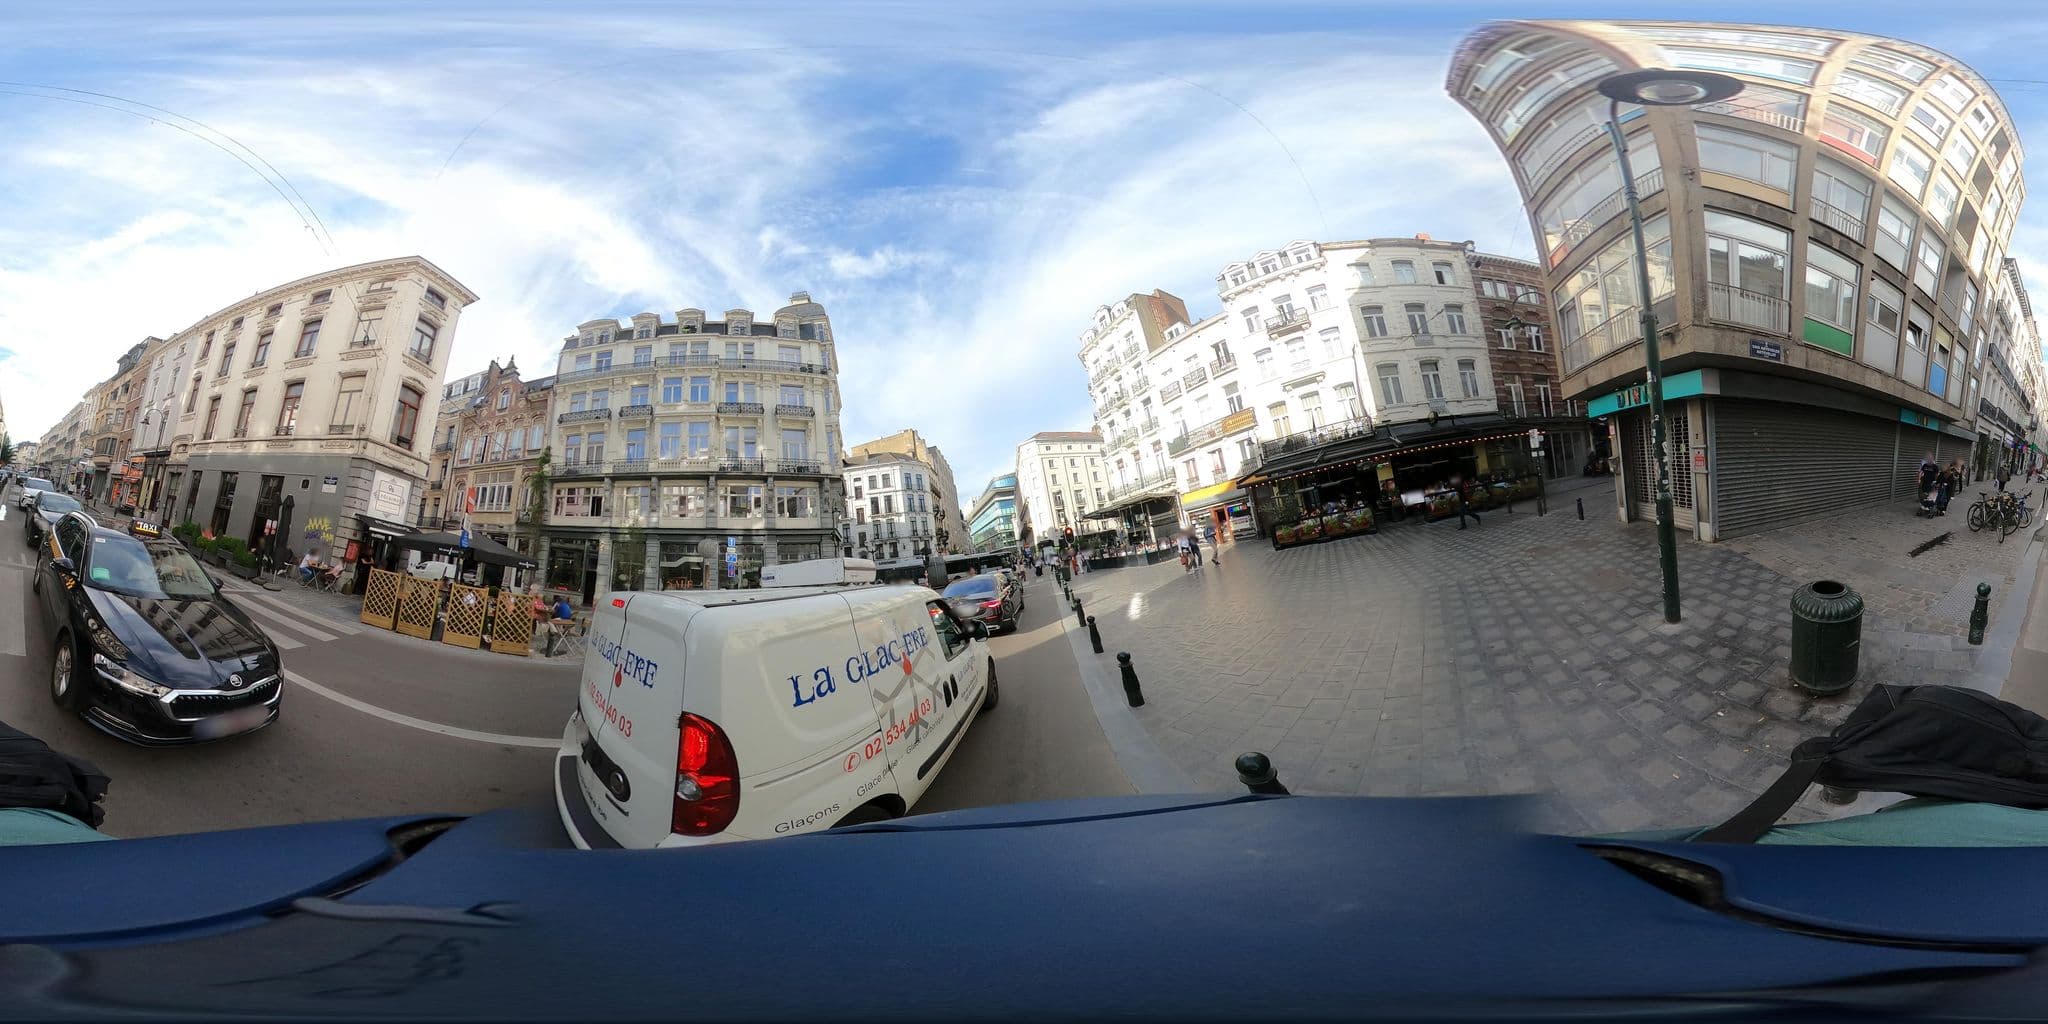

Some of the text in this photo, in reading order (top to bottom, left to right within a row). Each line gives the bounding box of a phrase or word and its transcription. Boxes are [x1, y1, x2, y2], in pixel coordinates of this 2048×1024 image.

[137, 521, 157, 531] TAXI
[606, 705, 617, 724] 40
[619, 715, 632, 738] 03
[864, 699, 931, 760] 02 534 40 03
[774, 803, 840, 834] Glaçons
[857, 774, 881, 797] Glace
